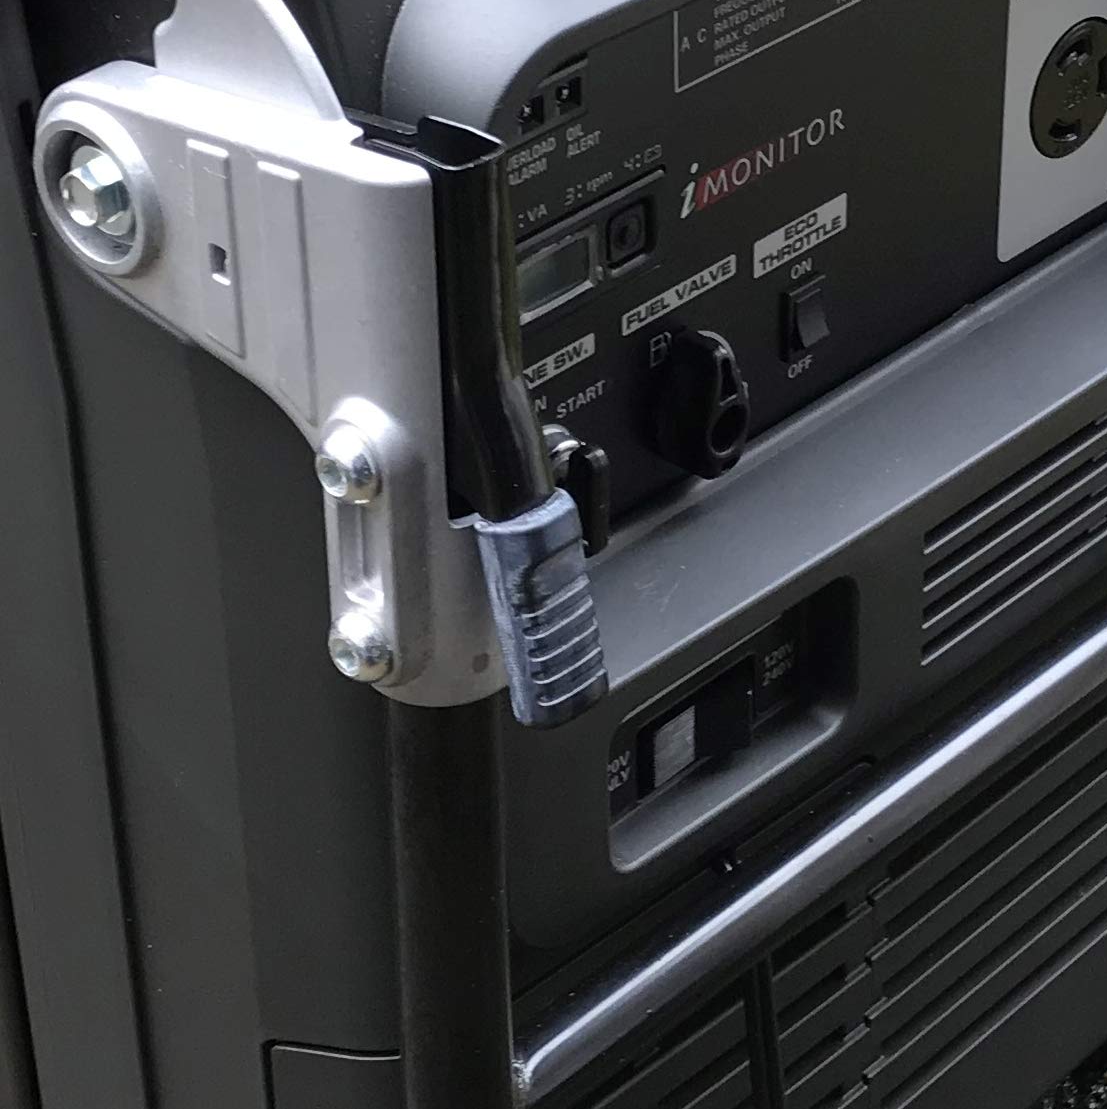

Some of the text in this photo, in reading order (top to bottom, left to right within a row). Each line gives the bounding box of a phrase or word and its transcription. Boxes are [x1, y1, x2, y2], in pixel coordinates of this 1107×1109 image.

[713, 10, 749, 35] RATED
[713, 7, 786, 51] MAX OUTPUT
[714, 41, 749, 66] PHASE
[566, 124, 584, 142] OIL
[566, 131, 601, 158] ALERT
[784, 212, 818, 241] ECO
[759, 216, 843, 271] THROTTLE
[790, 258, 812, 280] ON
[626, 260, 733, 329] FUEL VALVE
[553, 342, 588, 370] SW.
[788, 355, 813, 379] OFF
[556, 380, 606, 419] START
